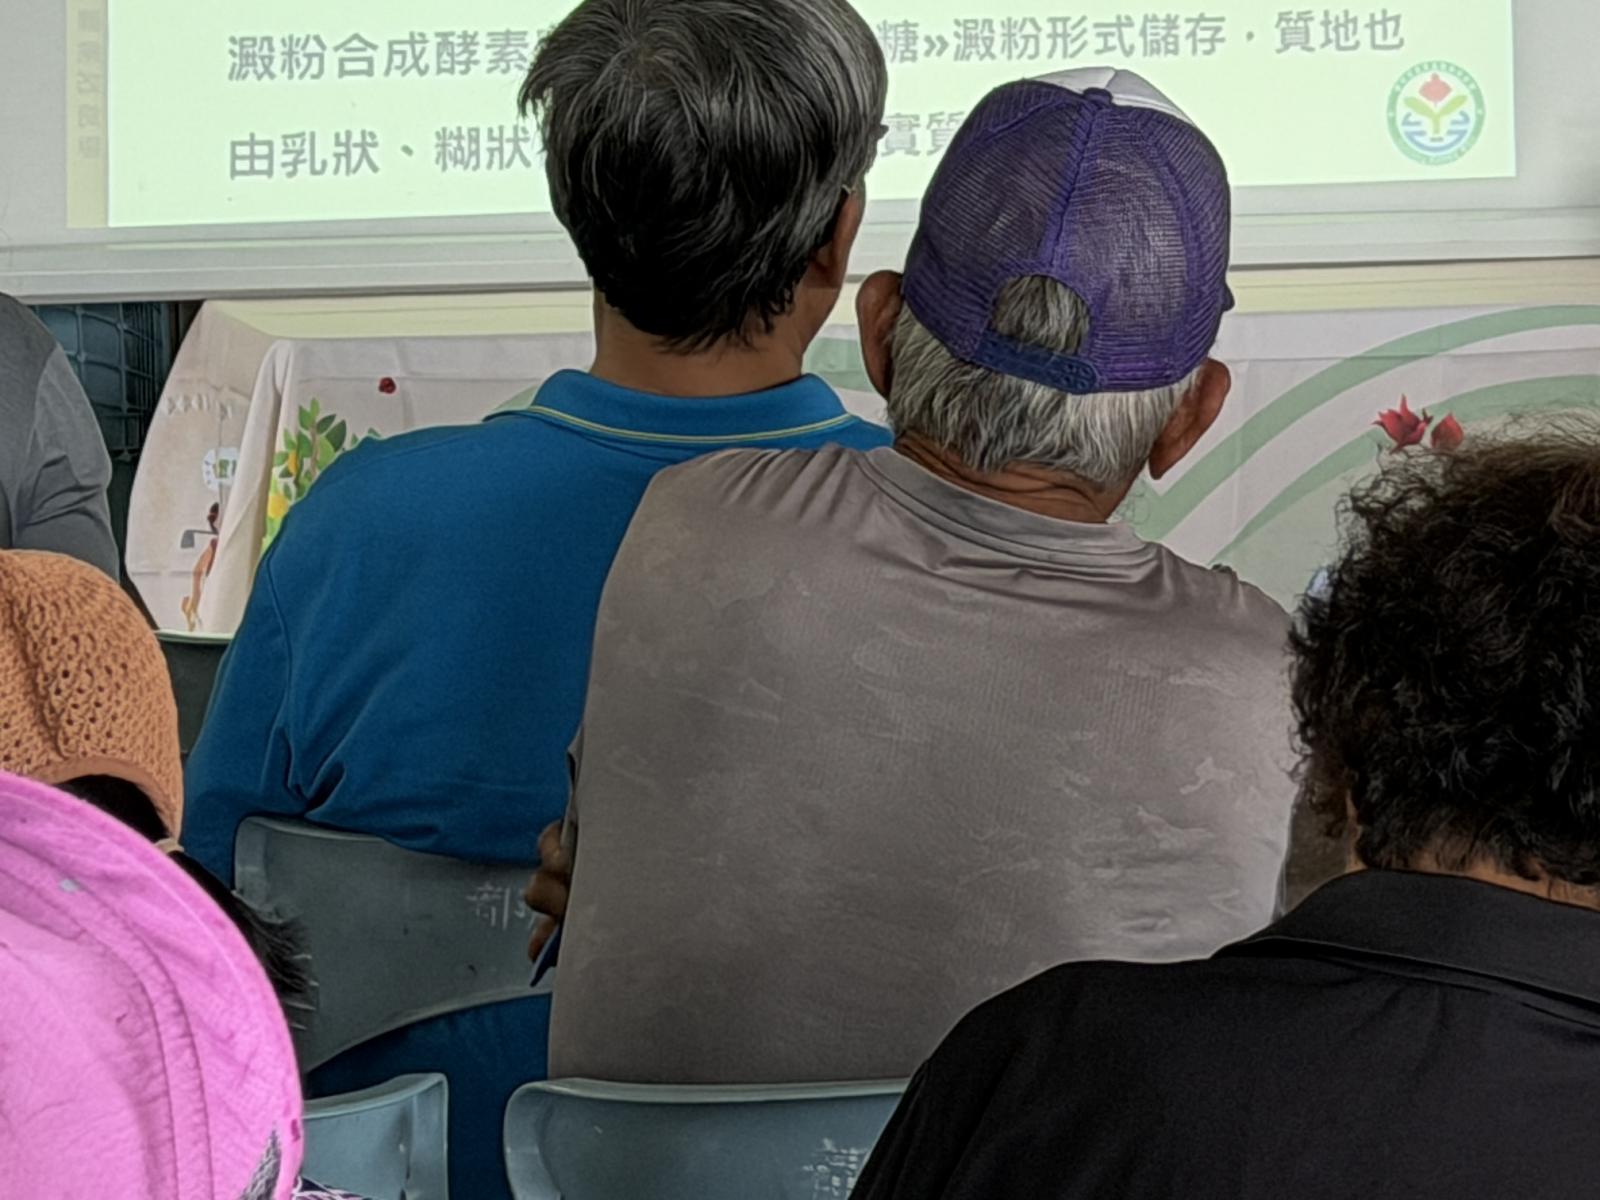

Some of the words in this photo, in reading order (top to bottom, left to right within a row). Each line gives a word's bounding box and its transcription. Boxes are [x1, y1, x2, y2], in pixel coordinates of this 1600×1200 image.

[226, 29, 553, 82] 澱粉合成酵素
